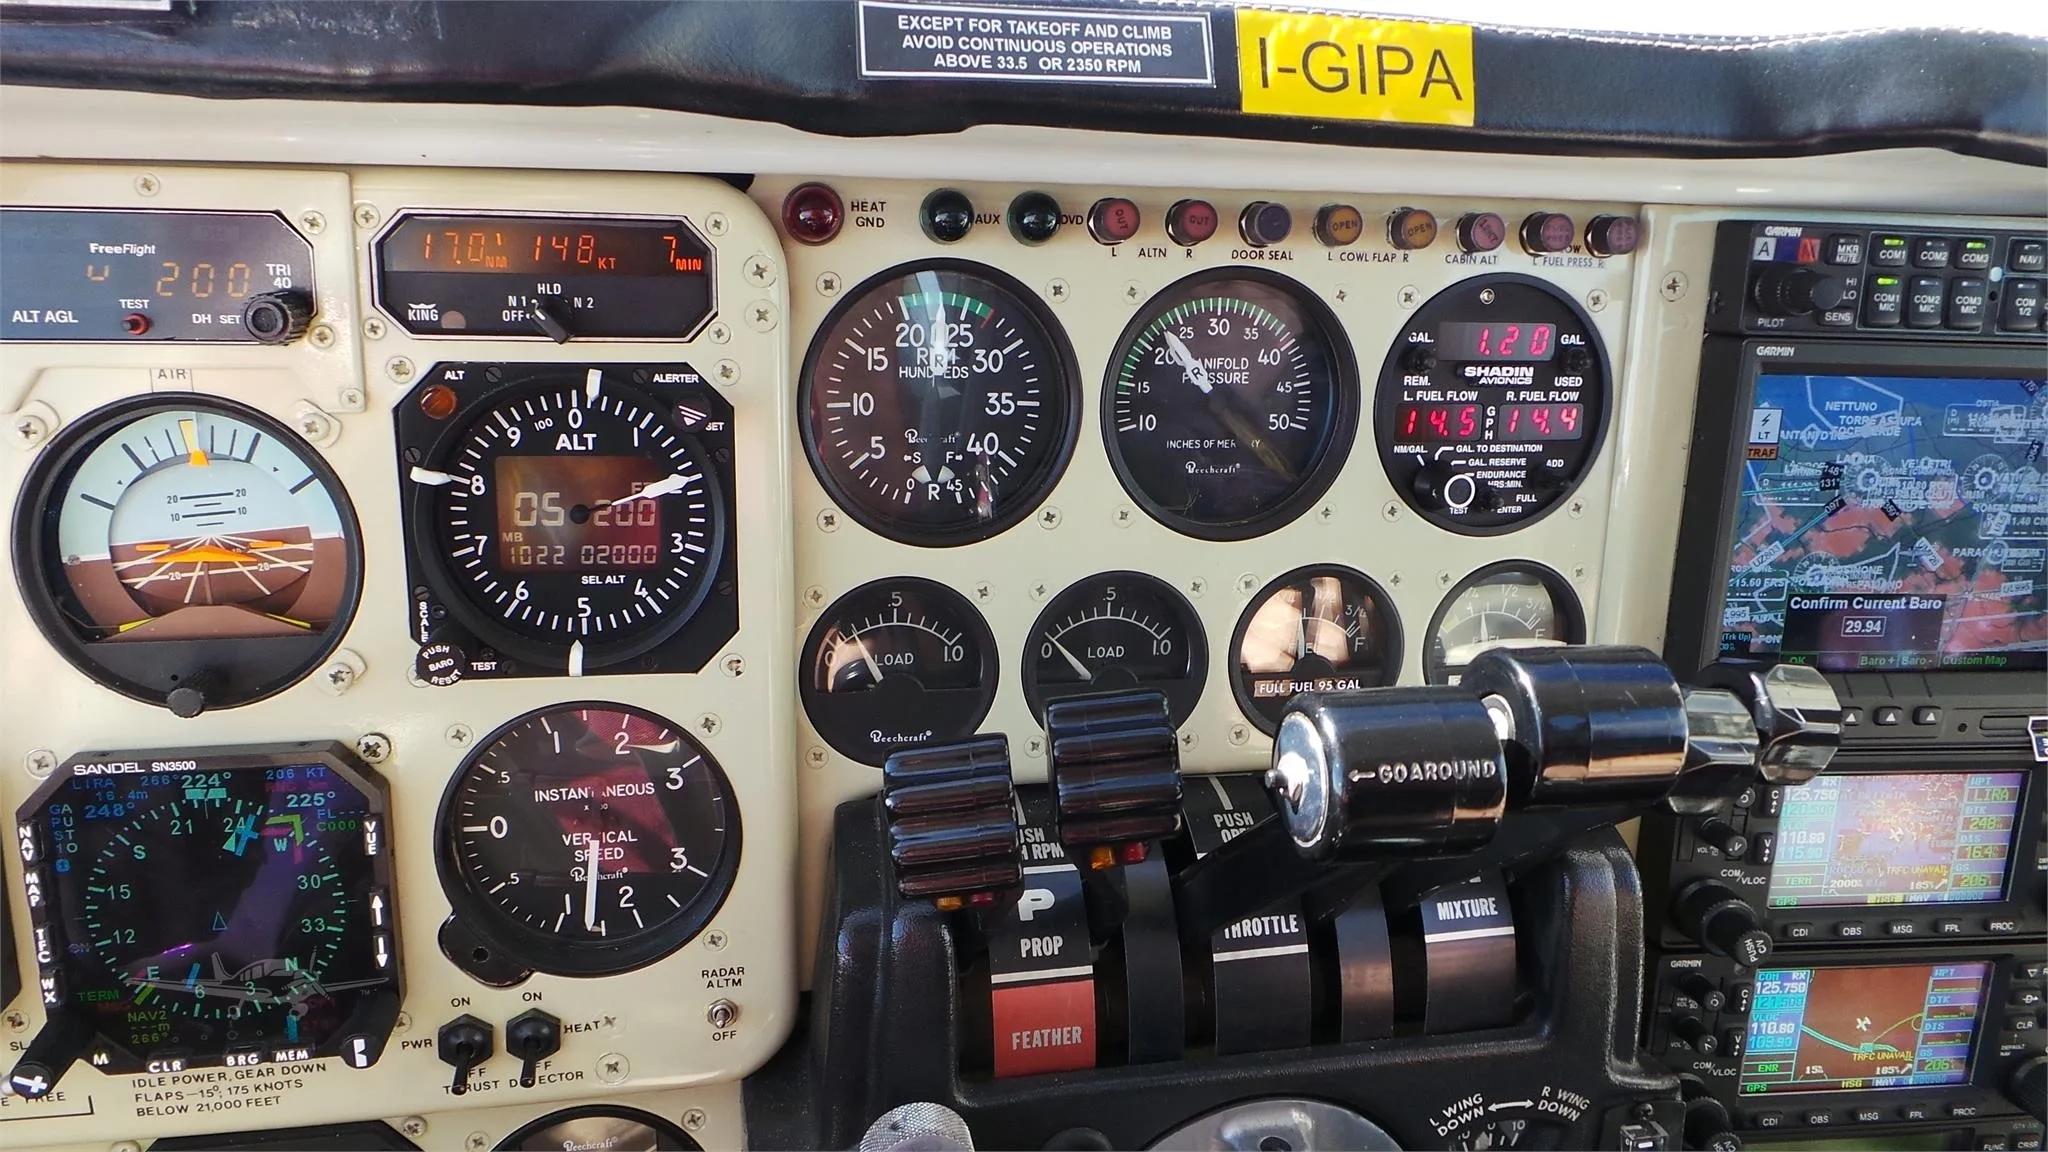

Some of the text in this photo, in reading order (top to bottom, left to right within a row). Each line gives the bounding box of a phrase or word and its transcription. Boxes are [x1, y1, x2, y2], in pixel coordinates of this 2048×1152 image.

[898, 15, 1172, 39] EXCEPT FOR TAKEOFF AND CLIMB
[902, 35, 1172, 57] AVOID CONTINUOUS OPERATIONS
[934, 53, 1141, 73] ABOVE 33.5 OR 2350 RPM
[1259, 36, 1464, 101] I-GIPA
[851, 201, 887, 228] HEAT GND
[975, 214, 1000, 225] AUX
[1765, 226, 1802, 237] GARMIN
[90, 243, 155, 256] FreeFlight
[534, 234, 594, 264] 148
[1139, 247, 1166, 258] ALTN
[1232, 249, 1293, 260] DOOR SEAL
[1340, 252, 1396, 263] COWL FLAP
[1445, 253, 1498, 264] CABIN ALT
[1921, 251, 1948, 261] COM2
[1962, 253, 1988, 263] COM3
[266, 264, 291, 276] TRI
[676, 258, 702, 271] MIN
[274, 277, 291, 288] 40
[537, 283, 561, 294] HLD
[120, 299, 149, 309] TEST
[1915, 294, 1940, 304] COM2
[1956, 295, 1981, 305] COM3
[1879, 302, 1895, 311] MIC
[1920, 304, 1935, 313] MIC
[1961, 305, 1977, 313] MIC
[12, 311, 78, 323] ALT AGL
[192, 313, 241, 324] DH SET
[408, 308, 438, 321] KING
[502, 310, 524, 322] OFF
[1825, 313, 1851, 322] SENS
[1208, 319, 1230, 335] 30
[1758, 318, 1784, 327] PILOT
[896, 324, 925, 347] 20
[1180, 327, 1194, 338] 25
[1480, 326, 1549, 356] 1.20
[1561, 335, 1585, 345] GAL.
[1258, 349, 1280, 365] 40
[1757, 347, 1794, 356] GARMIN
[868, 348, 888, 371] 15
[972, 350, 1003, 372] 30
[158, 369, 186, 379] AIR
[445, 370, 465, 380] ALT
[1464, 367, 1534, 377] SHADIN
[653, 373, 699, 384] ALERTER
[1404, 376, 1430, 385] REM.
[1479, 377, 1533, 385] AVIONICS
[1554, 377, 1583, 386] USED
[1138, 383, 1150, 393] 15
[1277, 382, 1292, 393] 45
[1417, 391, 1477, 401] FUEL FLOW
[1520, 392, 1579, 401] FUEL FLOW
[853, 393, 874, 415] 10
[985, 393, 1015, 415] 35
[1825, 402, 1877, 410] NETTUNO
[1139, 415, 1156, 430] 10
[1269, 415, 1289, 430] 50
[1407, 407, 1476, 436] 14.5
[1508, 408, 1577, 434] 14.4
[556, 434, 596, 450] ALT
[967, 433, 999, 456] 40
[1167, 440, 1200, 449] INCHES
[1477, 471, 1526, 479] ENDURANCE
[1516, 494, 1537, 502] FULL
[502, 532, 523, 543] MB
[509, 545, 657, 565] 1022 02000
[581, 575, 626, 585] SEL ALT
[1790, 597, 1942, 609] Confirm Current Baro
[1845, 621, 1881, 633] 29.94
[1088, 646, 1125, 658] LOAD
[428, 658, 454, 671] BARO
[1943, 654, 2007, 666] Custom Map
[471, 661, 497, 671] TEST
[1259, 679, 1360, 694] FULL FUEL 95 GAL
[73, 760, 196, 776] SANDEL SN3500
[266, 768, 295, 780] 206
[182, 772, 231, 789] 224°
[287, 791, 335, 808] 225°
[1974, 789, 2009, 800] LIRA
[1214, 812, 1254, 828] PUSH
[1034, 843, 1064, 859] RPM
[297, 874, 321, 889] 30
[107, 885, 131, 900] 15
[1437, 898, 1498, 920] MIXTURE
[302, 918, 326, 933] 33
[1843, 926, 1861, 936] OBS
[1893, 925, 1912, 934] MSG
[1945, 923, 1960, 932] FPL
[113, 929, 136, 944] 12
[1793, 927, 1808, 936] CDI
[1020, 936, 1063, 957] PROP
[1671, 960, 1702, 968] GARMIN
[701, 967, 745, 978] RADAR
[706, 978, 742, 989] ALTM
[1756, 982, 1806, 994] 125.750
[77, 990, 119, 1001] TERM
[522, 992, 542, 1002] ON
[451, 997, 470, 1008] ON
[128, 1011, 167, 1022] NAV2
[564, 1021, 600, 1034] HEAT
[712, 1030, 737, 1041] OFF
[1011, 1027, 1082, 1050] FEATHER
[401, 1038, 433, 1049] PWR
[226, 1054, 259, 1066] BRG
[275, 1051, 309, 1062] MEM
[1878, 1051, 1913, 1060] UNAVAIL
[149, 1061, 182, 1072] CLR
[133, 1063, 326, 1088] IDLE GEAR DOWN
[135, 1079, 303, 1102] FLAPS 175 KNOTS
[137, 1096, 281, 1117] BELOW 21,000 FEET
[1442, 1093, 1483, 1118] WING
[1437, 1106, 1484, 1137] DOWN
[1763, 1117, 1778, 1126] CDI
[1810, 1114, 1829, 1124] OBS
[1860, 1111, 1879, 1121] MSG
